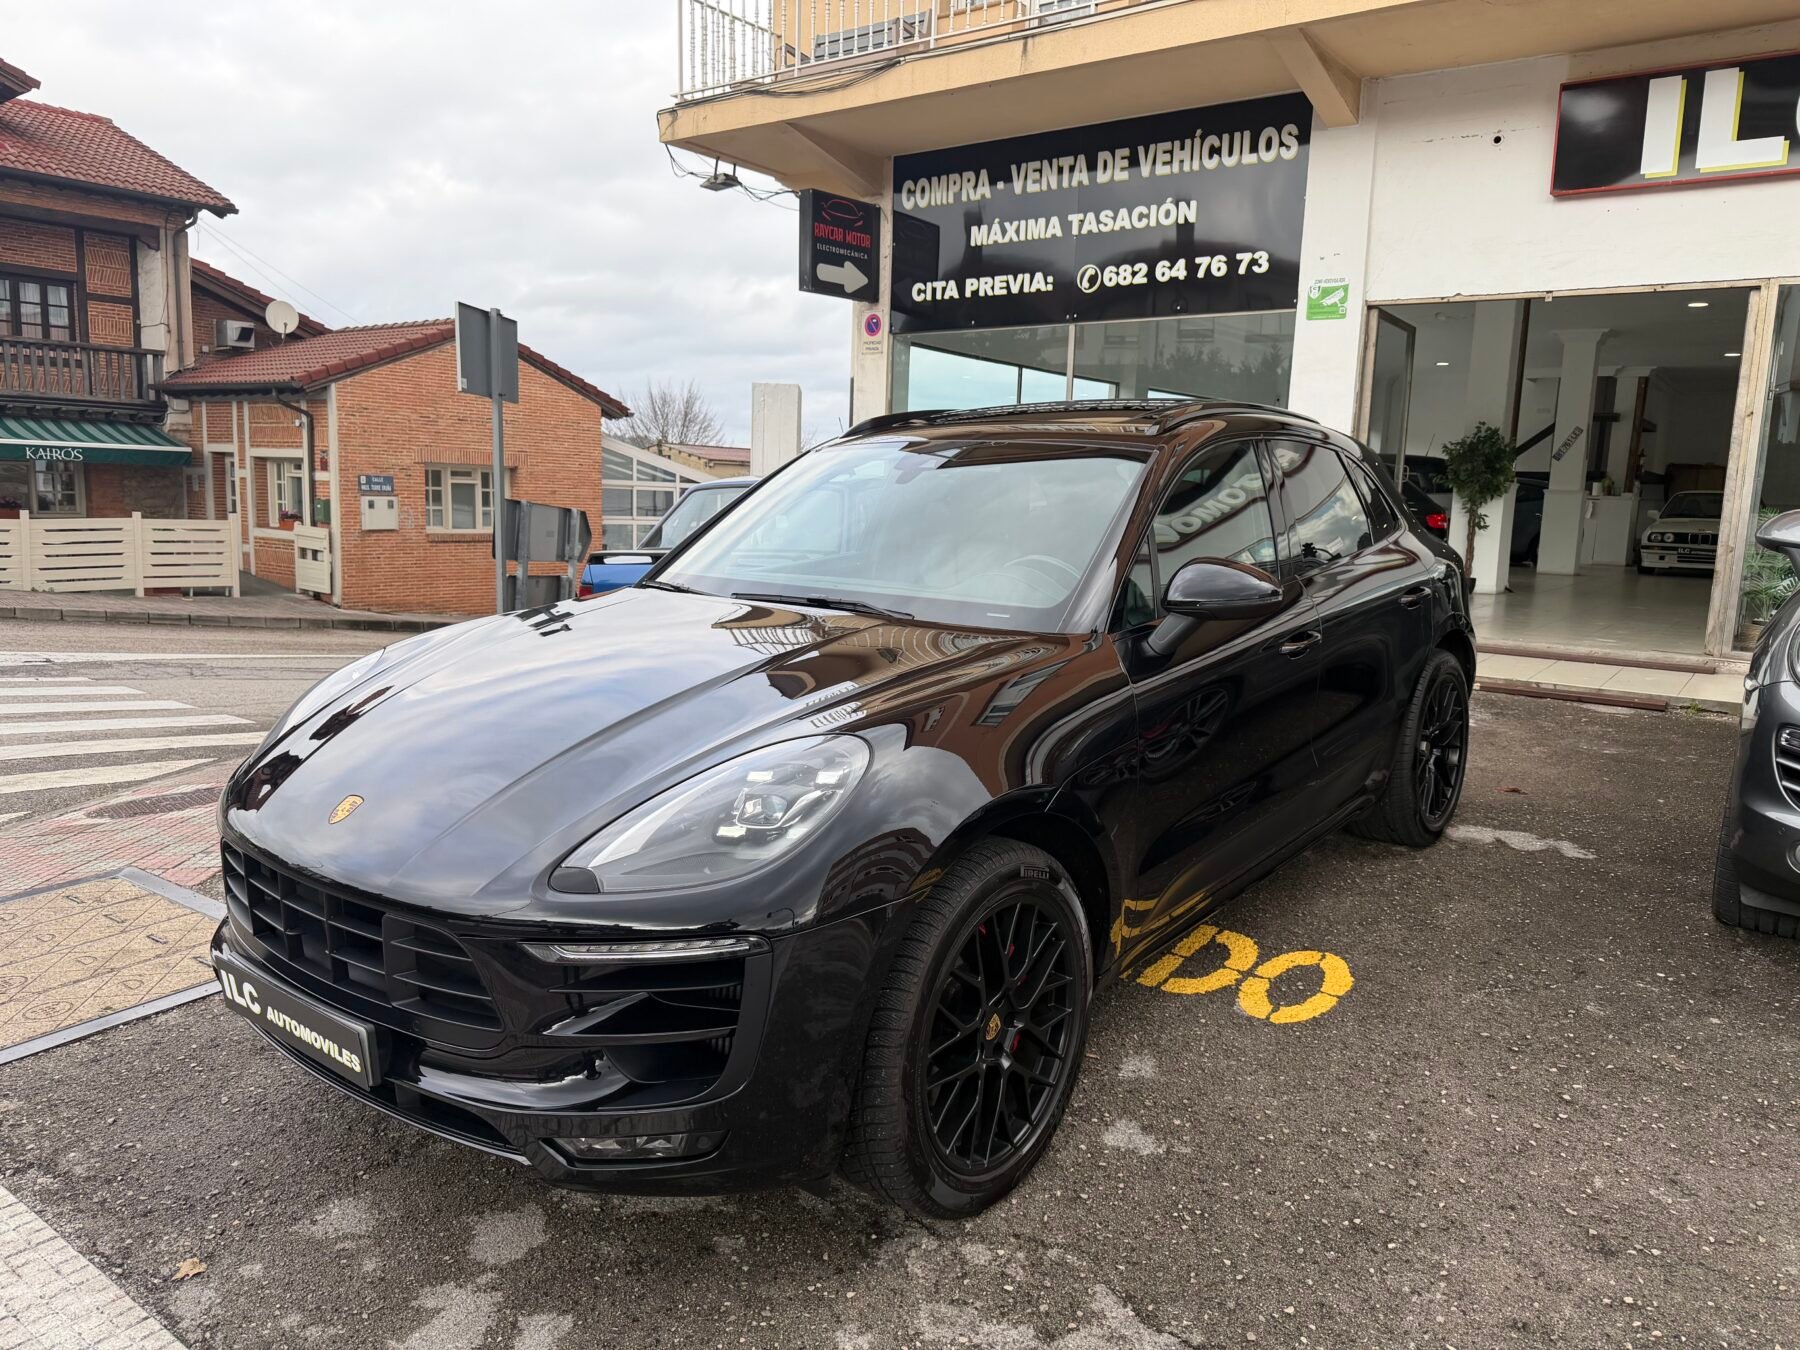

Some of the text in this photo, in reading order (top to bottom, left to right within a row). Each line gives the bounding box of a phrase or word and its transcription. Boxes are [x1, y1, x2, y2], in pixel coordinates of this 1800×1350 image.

[1640, 67, 1800, 178] IL
[902, 168, 991, 210] COMPRA
[1010, 154, 1089, 195] VENTA
[1096, 147, 1130, 184] DE
[1137, 124, 1299, 178] VEHÍCULOS
[814, 222, 871, 248] RAYCAR MOTOR
[970, 197, 1197, 247] MÁXIMA TASACIÓN
[911, 250, 1269, 302] CITA PREVIA: 682 64 76 73
[1020, 864, 1050, 879] PIRELLI
[1119, 924, 1354, 1024] DO
[220, 969, 361, 1073] ILC AUTOMOVILES
